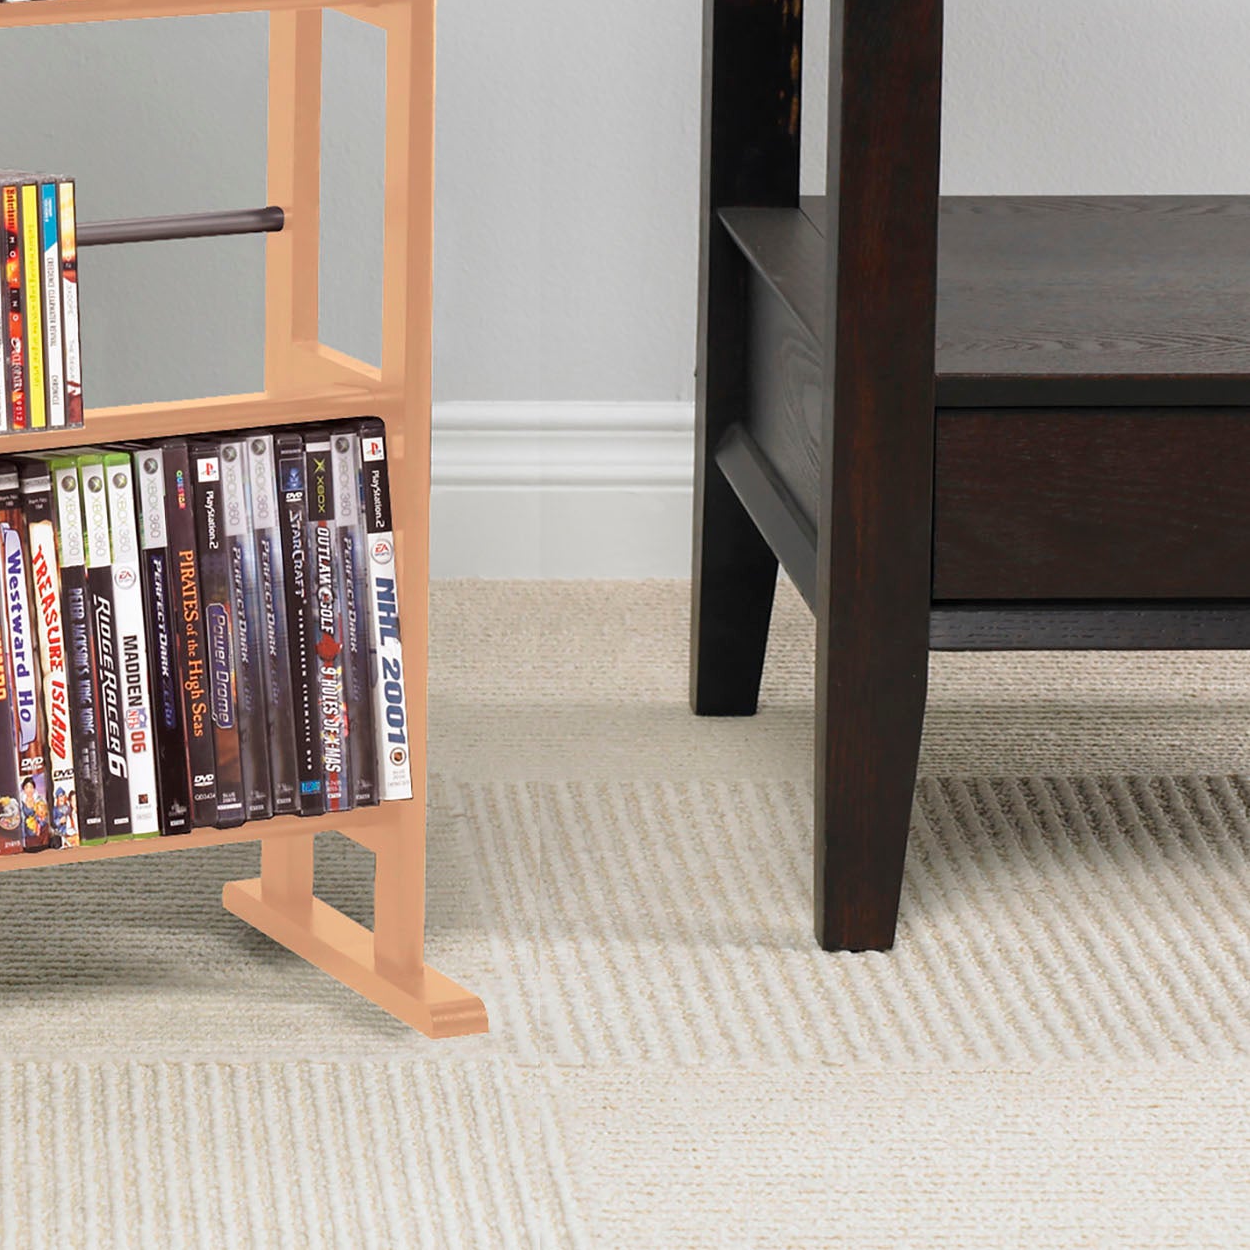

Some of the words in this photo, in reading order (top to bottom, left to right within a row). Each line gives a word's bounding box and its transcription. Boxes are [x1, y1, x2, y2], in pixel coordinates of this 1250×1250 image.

[317, 476, 326, 513] XBOX
[178, 550, 199, 622] PIRATES
[7, 550, 29, 677] Westward
[187, 624, 196, 634] of
[376, 577, 399, 647] NHL
[32, 545, 63, 672] TREASURE
[49, 680, 66, 759] ISLAND
[70, 588, 85, 620] PETER
[78, 679, 93, 705] KING
[188, 640, 198, 656] the
[213, 614, 227, 667] Power
[122, 635, 142, 707] MADDEN
[186, 659, 204, 699] High
[322, 666, 336, 675] 9
[17, 689, 32, 722] Ho
[215, 671, 231, 722] Drome
[322, 679, 338, 715] HOLES
[383, 658, 406, 744] 2001
[192, 703, 205, 737] Seas
[323, 718, 340, 733] OF
[131, 731, 146, 753] 06
[324, 736, 343, 773] X-MAS
[108, 753, 127, 778] 6
